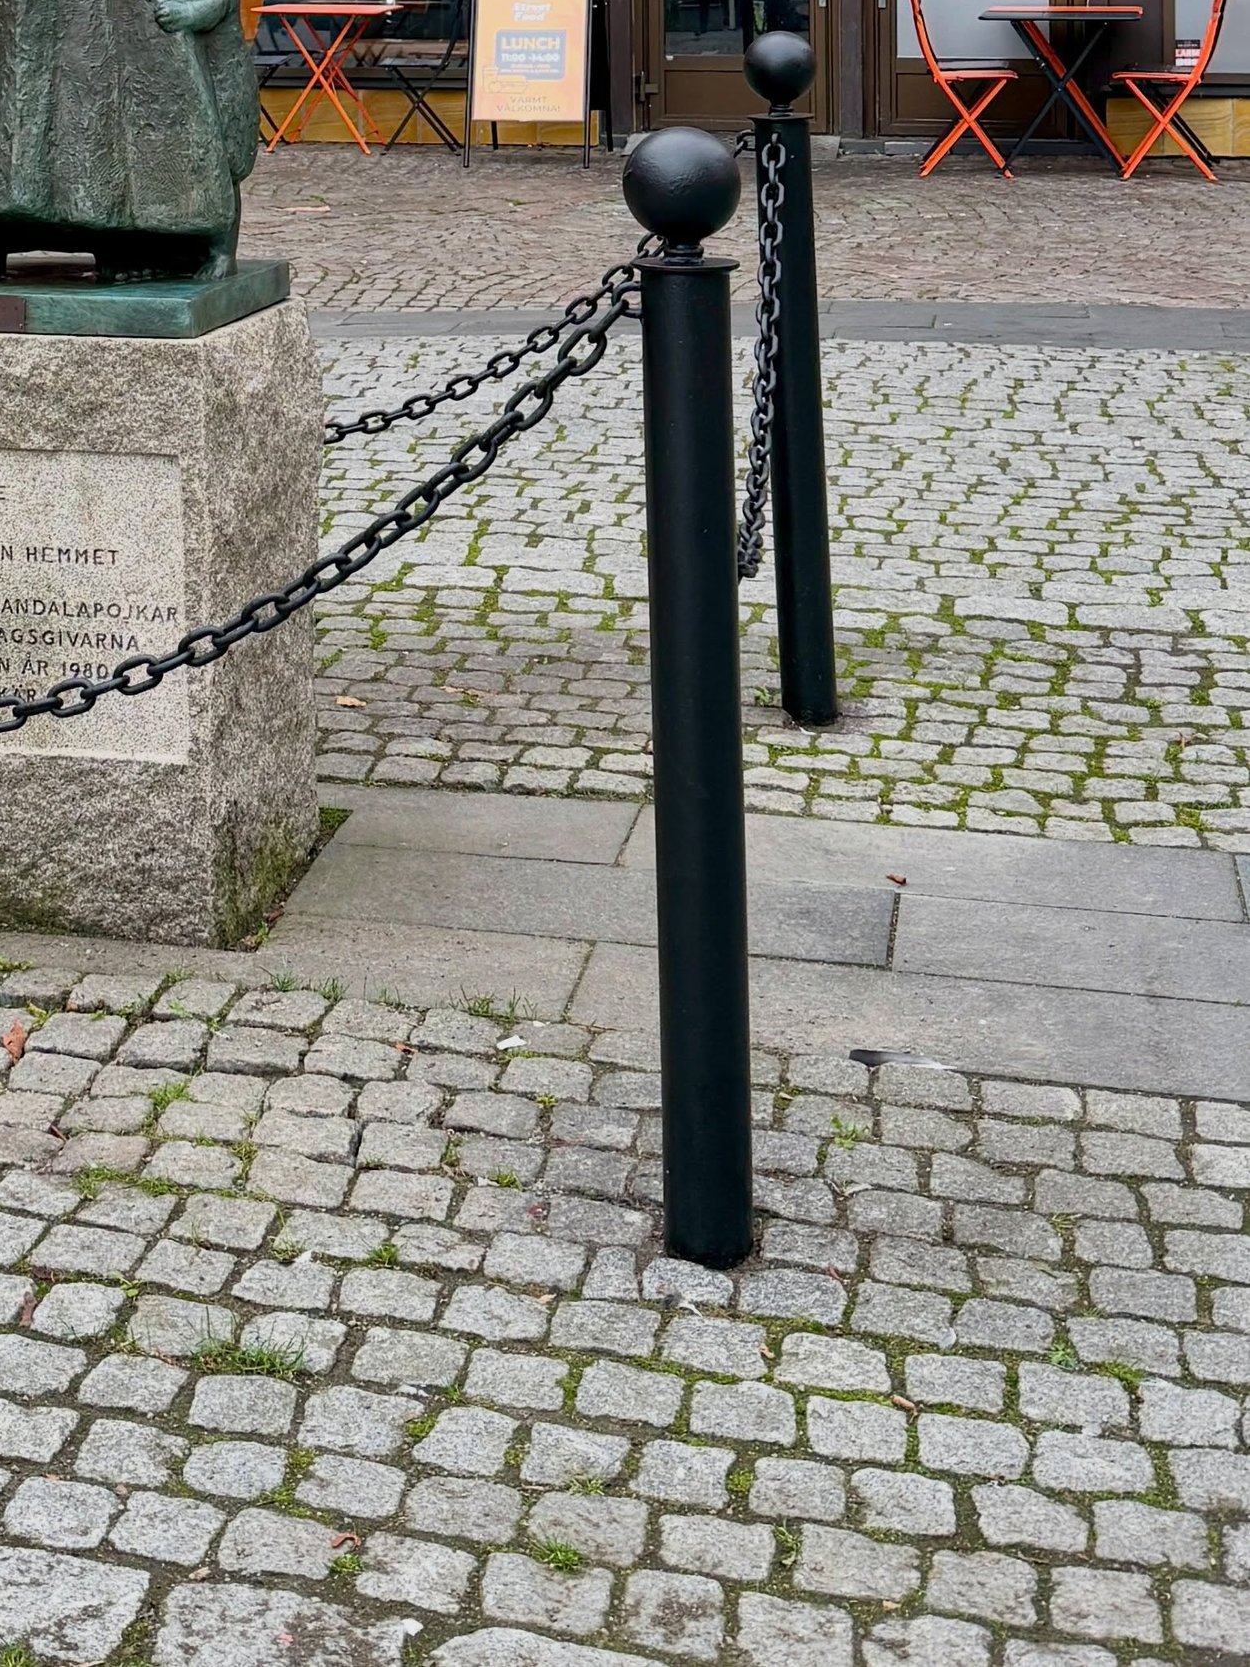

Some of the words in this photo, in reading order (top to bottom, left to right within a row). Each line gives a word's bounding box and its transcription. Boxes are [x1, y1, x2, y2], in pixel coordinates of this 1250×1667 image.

[501, 37, 560, 50] LUNCH
[26, 546, 120, 565] HEMMET
[21, 652, 49, 676] ÅR
[62, 662, 109, 679] 1980
